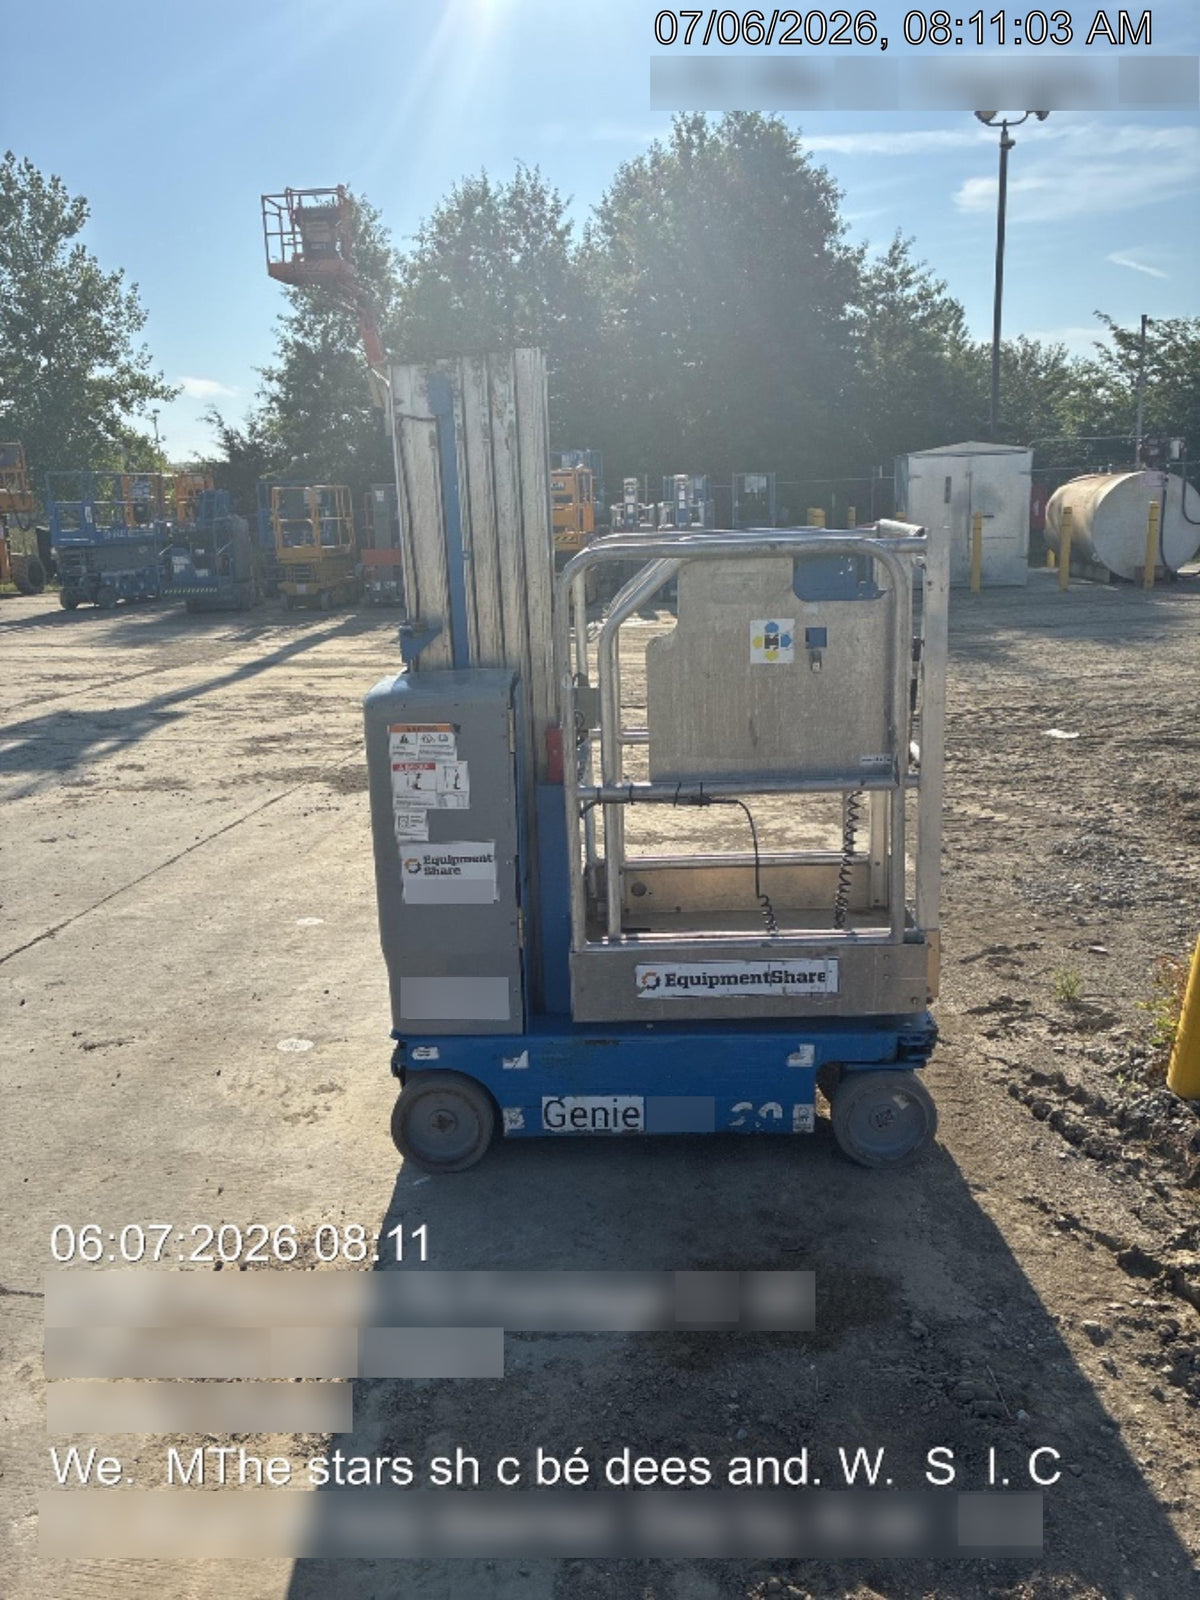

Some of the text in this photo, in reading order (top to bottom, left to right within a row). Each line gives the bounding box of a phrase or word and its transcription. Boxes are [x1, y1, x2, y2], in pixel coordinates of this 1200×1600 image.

[423, 854, 493, 866] Equipment
[424, 866, 461, 875] Share
[664, 969, 826, 989] EquipmentShare
[543, 1098, 640, 1128] Genie
